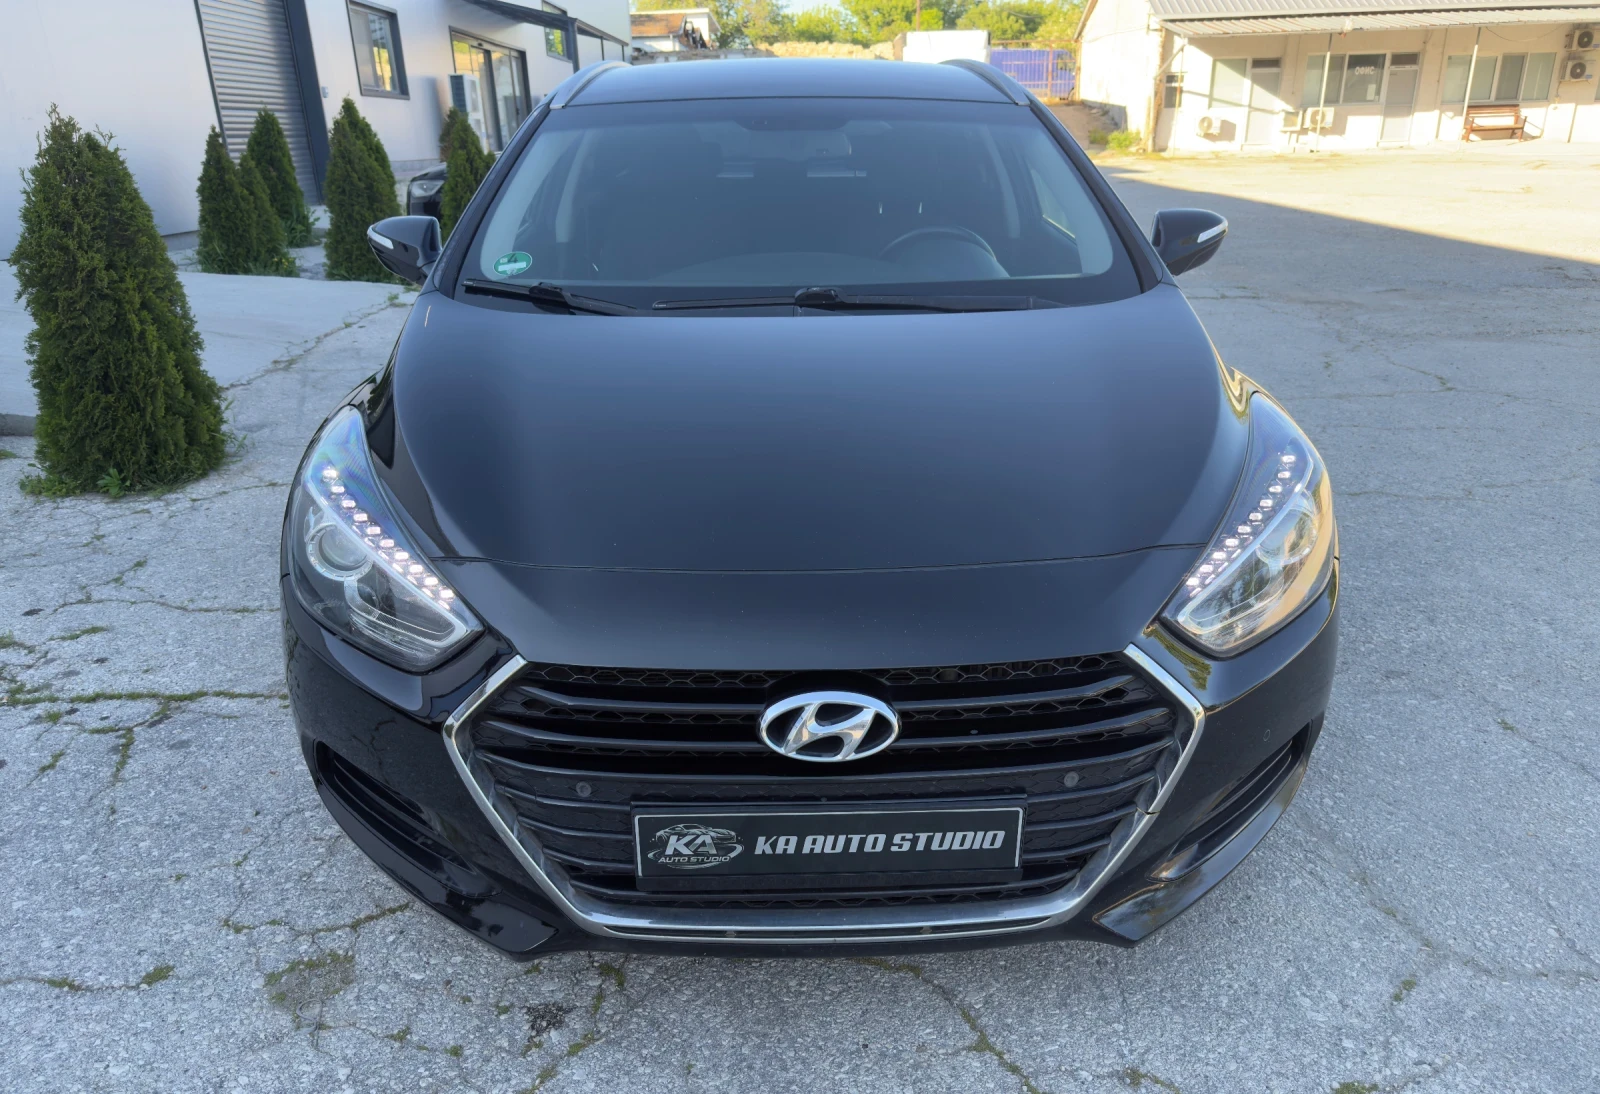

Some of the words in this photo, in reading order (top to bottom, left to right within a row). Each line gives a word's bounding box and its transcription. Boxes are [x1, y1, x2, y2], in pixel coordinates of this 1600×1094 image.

[1355, 66, 1375, 75] ОФИС
[665, 835, 717, 855] KA
[754, 836, 799, 855] KA
[801, 834, 887, 854] AUTO
[890, 831, 1005, 852] STUDIO
